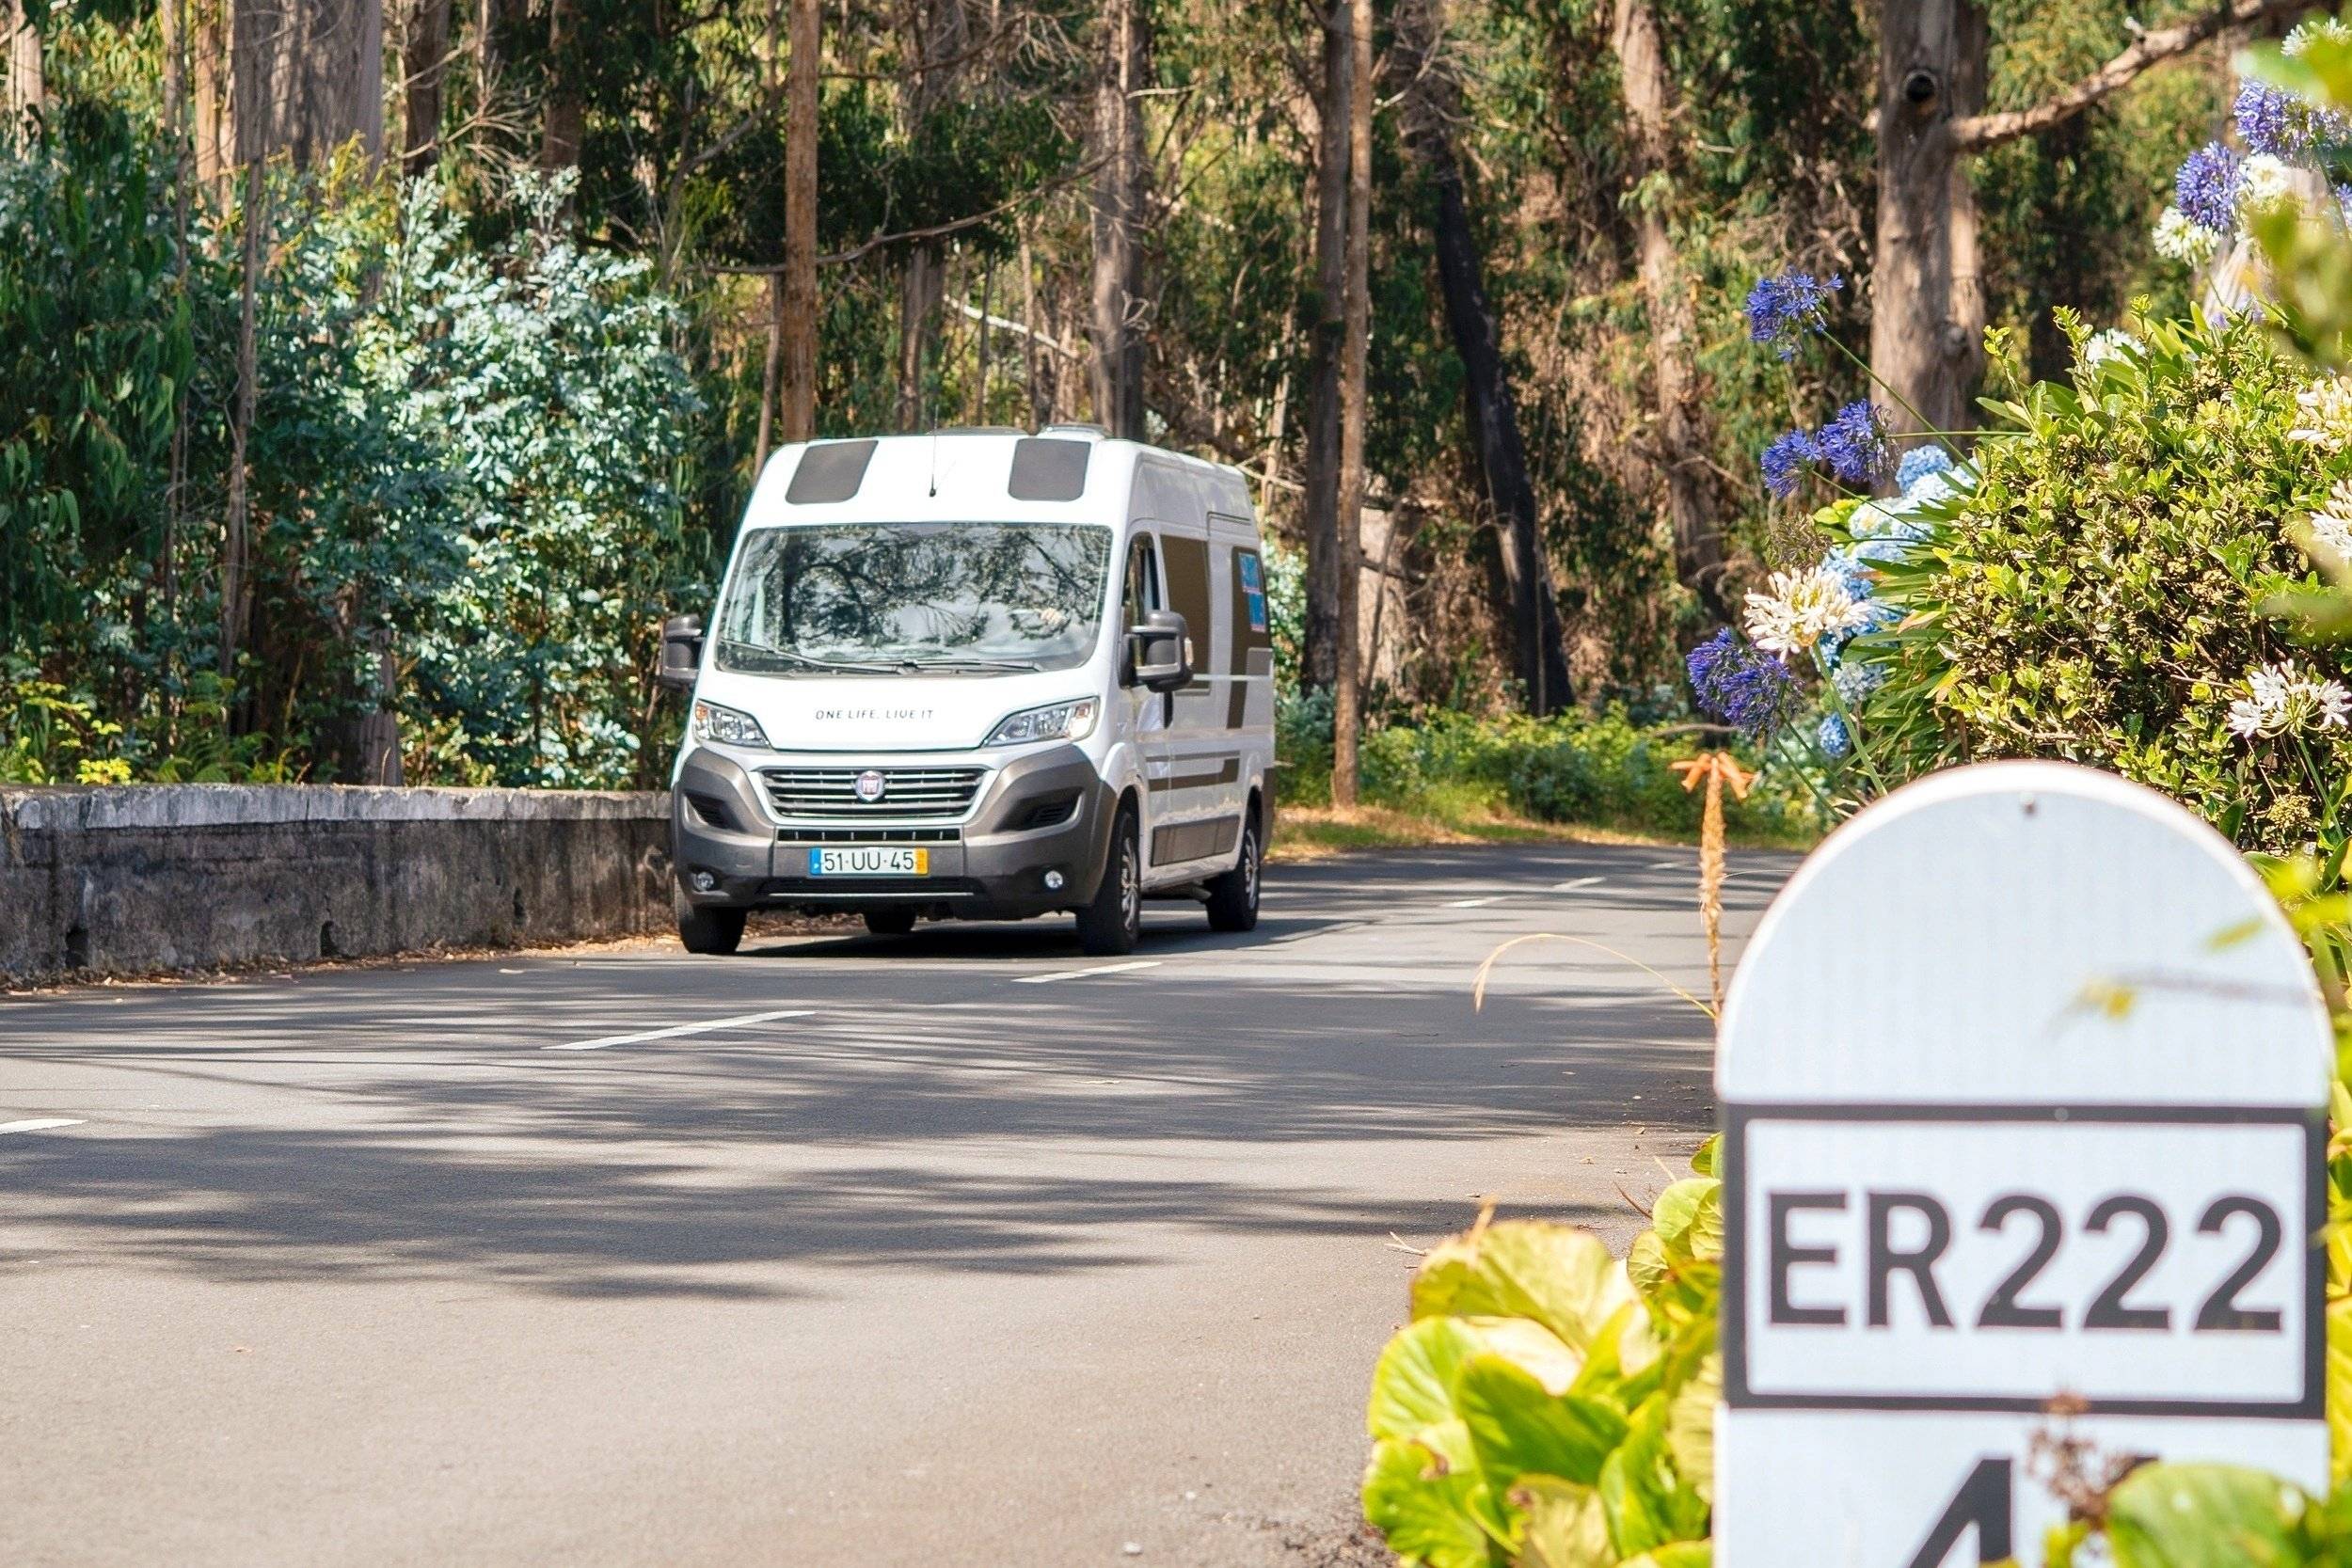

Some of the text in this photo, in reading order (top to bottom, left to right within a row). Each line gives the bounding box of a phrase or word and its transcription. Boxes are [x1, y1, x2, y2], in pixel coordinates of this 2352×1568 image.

[815, 709, 843, 721] ONE
[848, 709, 880, 720] LIFE.
[921, 709, 933, 720] IT
[1769, 1191, 2281, 1332] ER222
